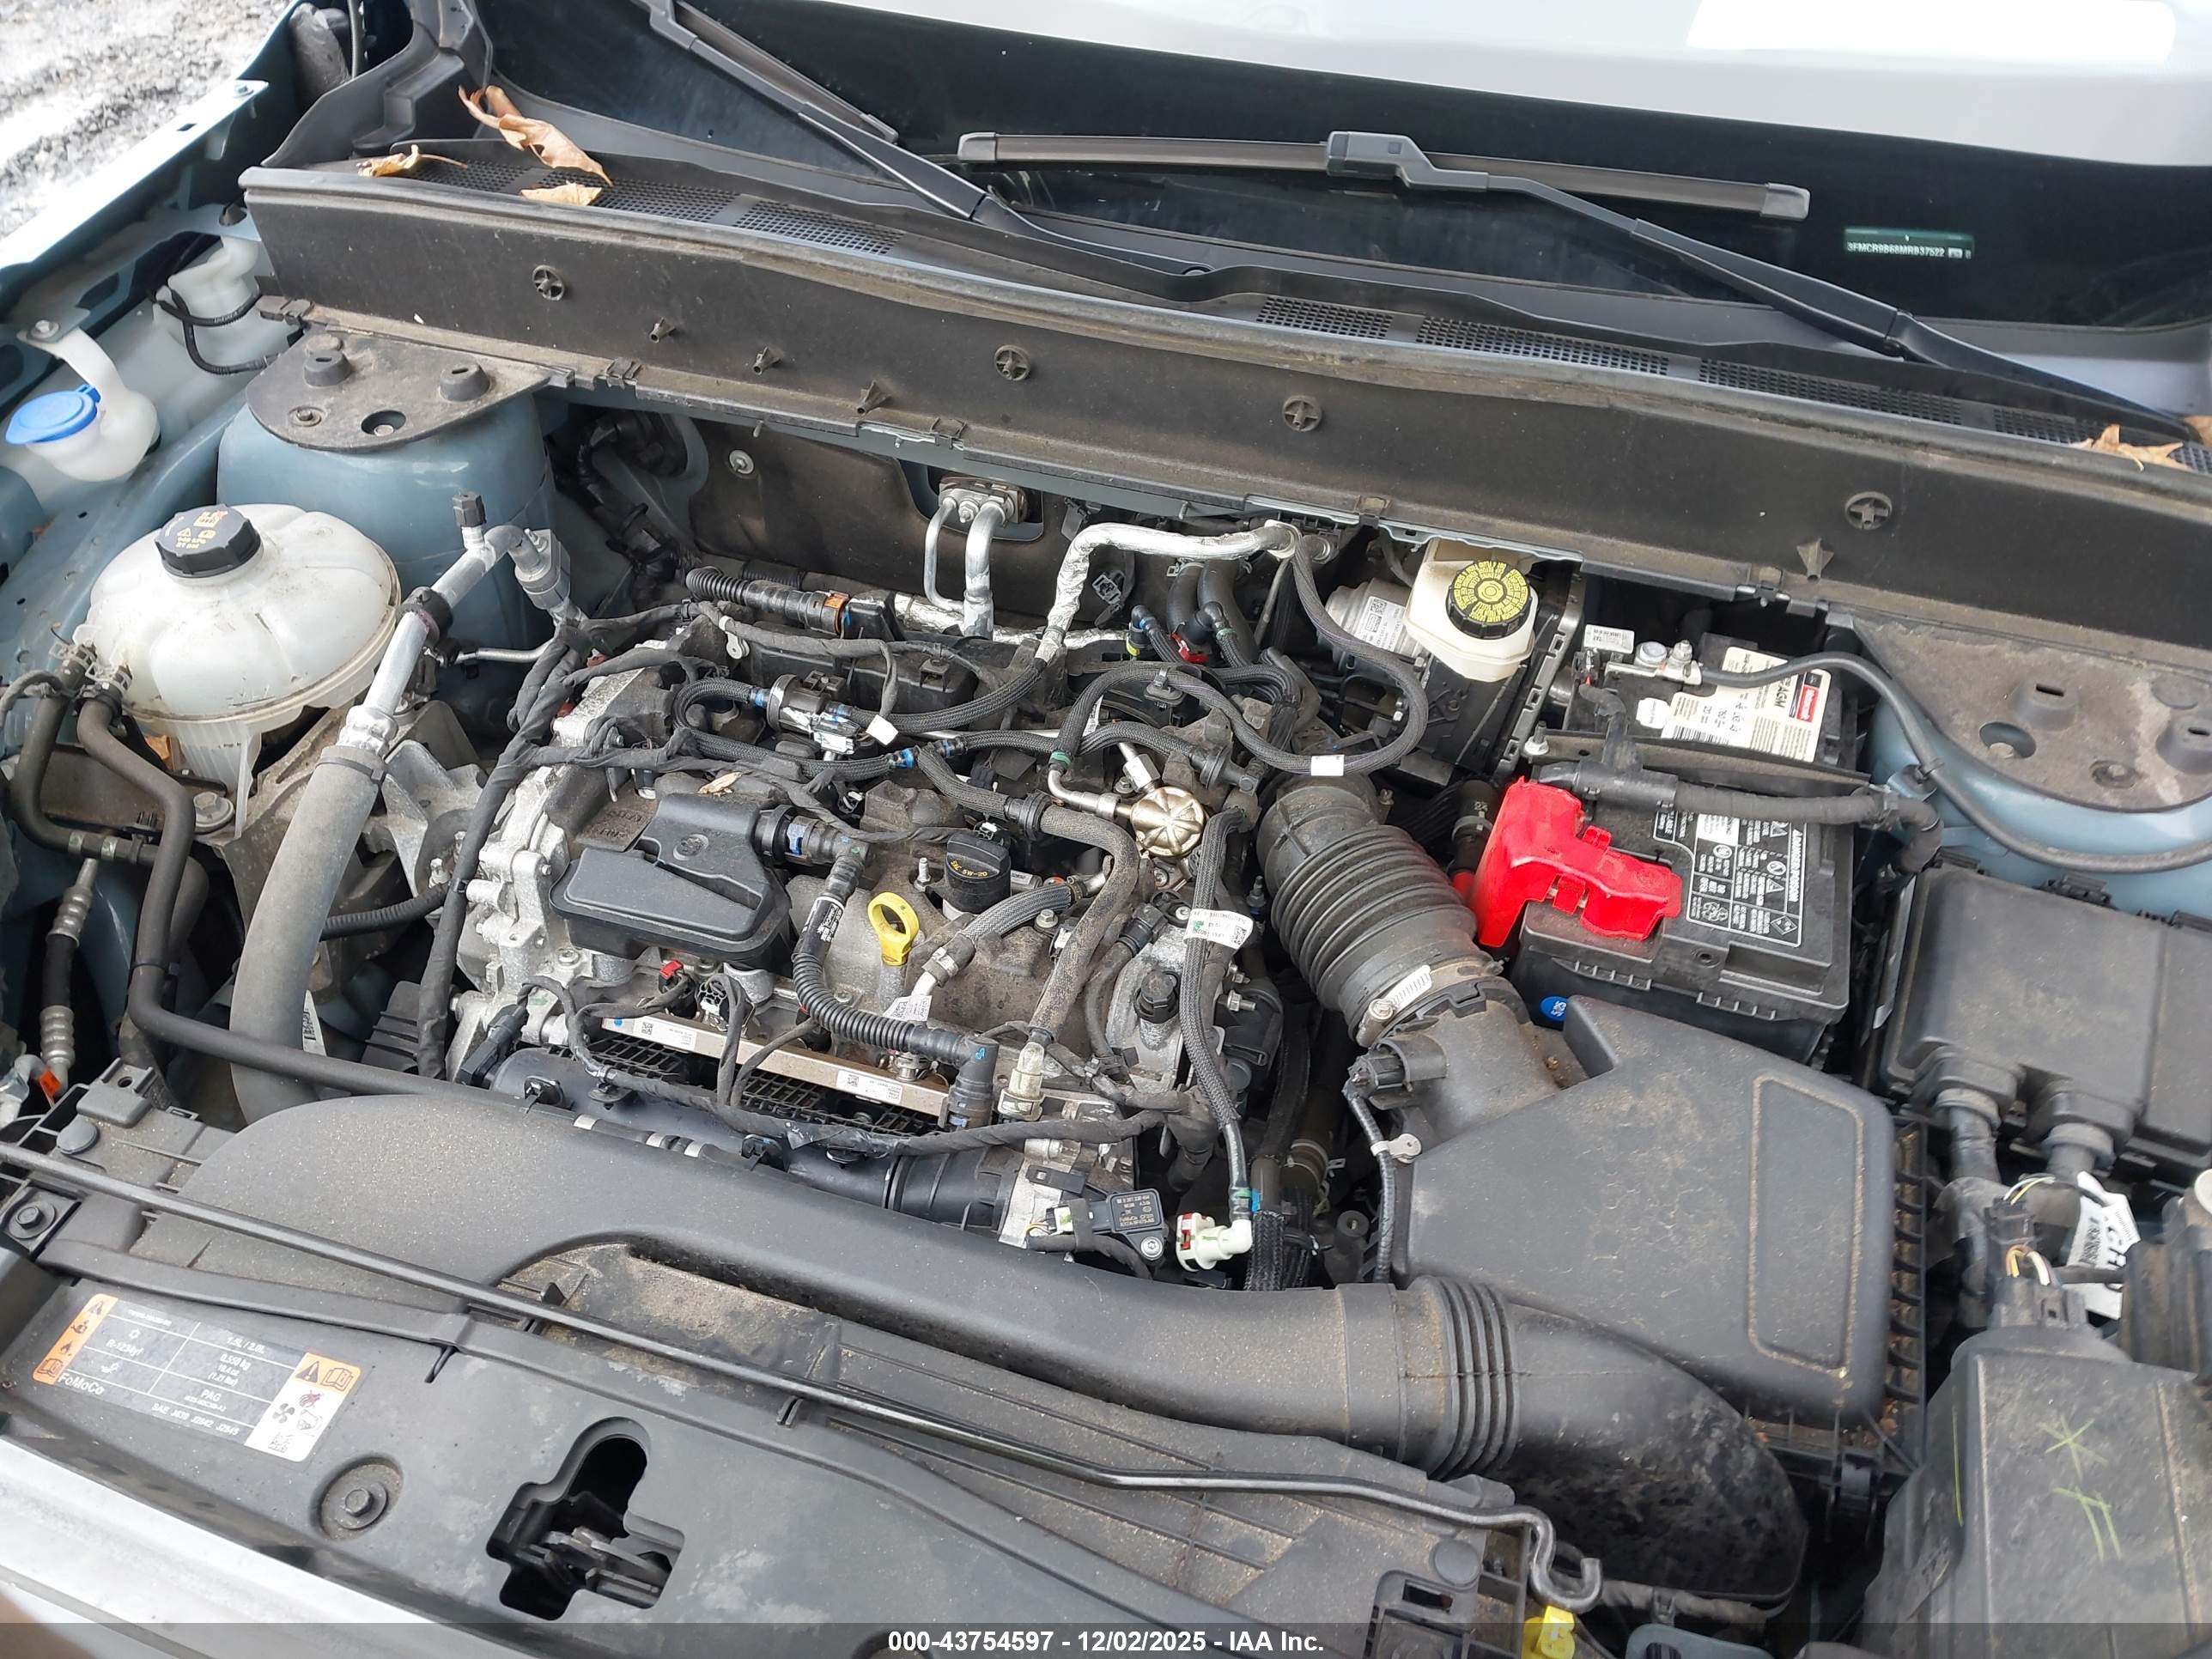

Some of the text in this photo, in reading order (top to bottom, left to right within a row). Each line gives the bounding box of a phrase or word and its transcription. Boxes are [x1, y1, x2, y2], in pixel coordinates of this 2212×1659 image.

[106, 1339, 144, 1358] R-1234yf
[58, 1372, 105, 1395] FoMoCo
[201, 1389, 221, 1402] PAG
[152, 1403, 168, 1413] SAE
